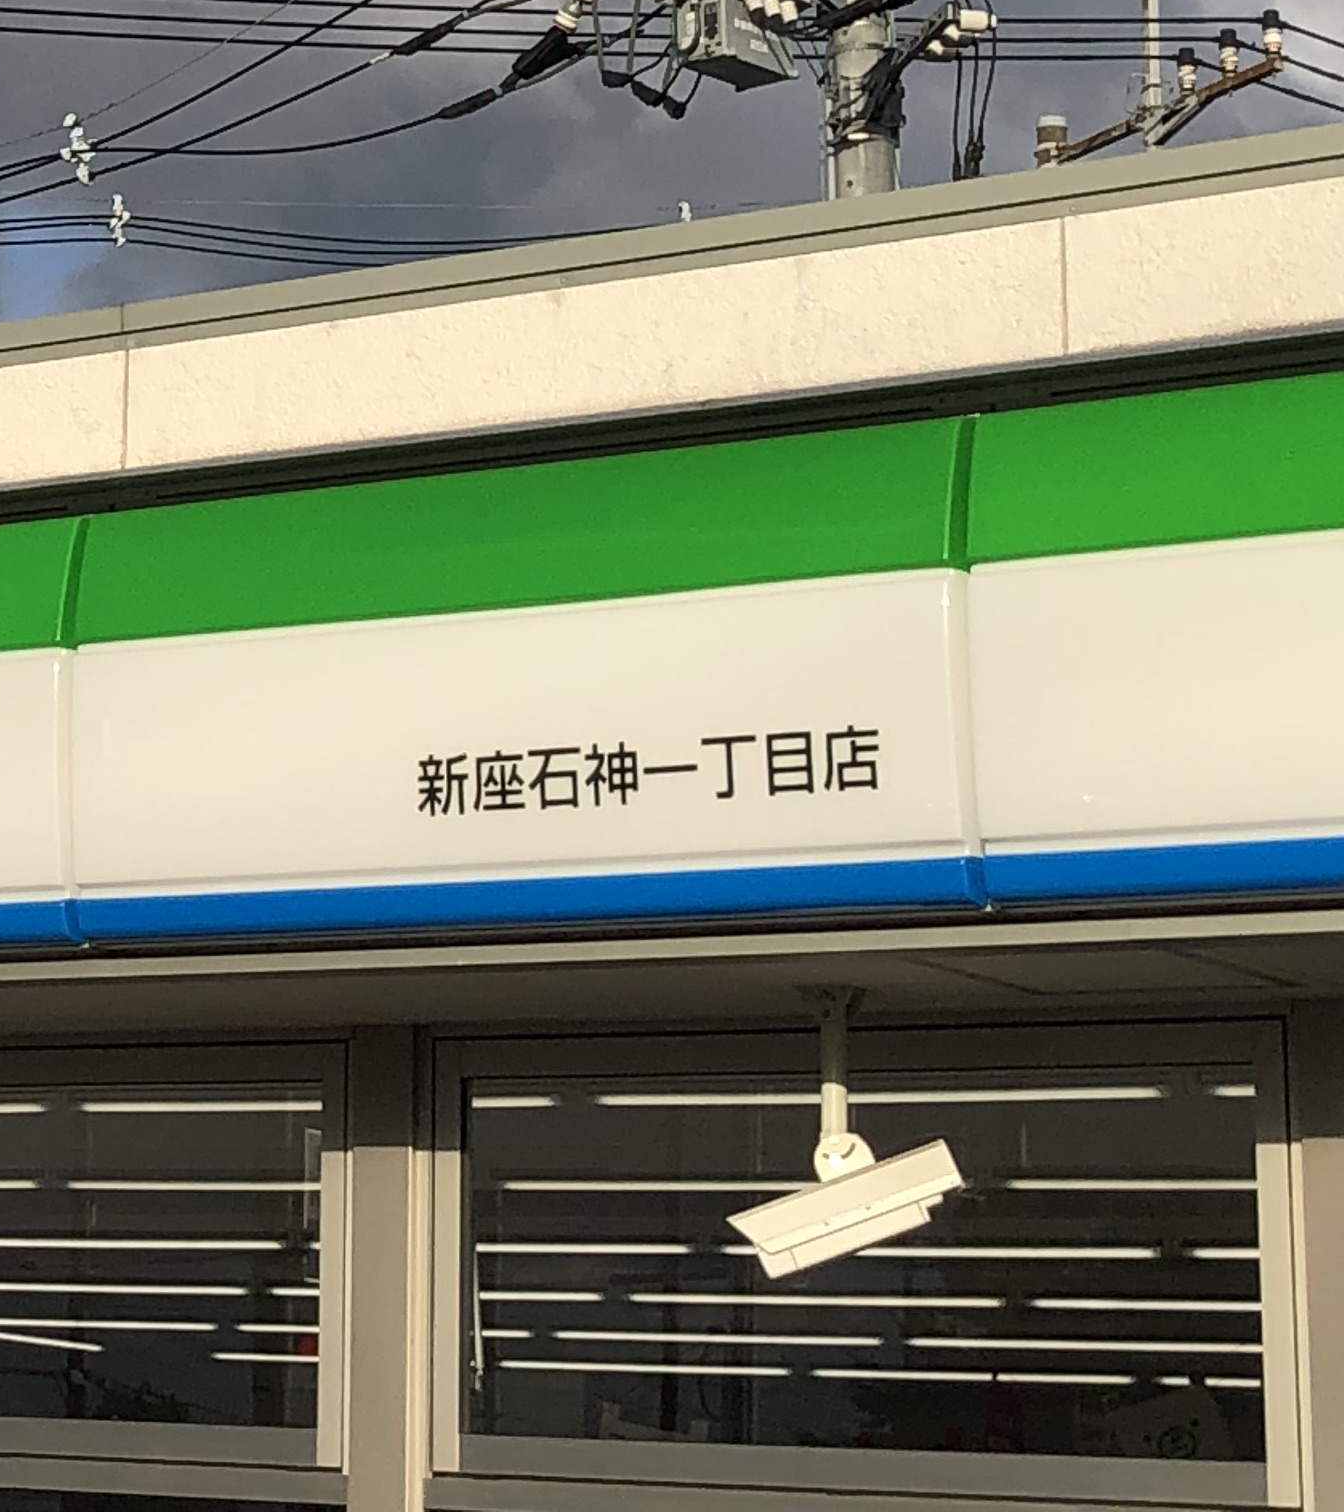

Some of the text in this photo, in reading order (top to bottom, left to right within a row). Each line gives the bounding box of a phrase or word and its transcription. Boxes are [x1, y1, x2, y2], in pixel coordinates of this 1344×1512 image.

[417, 724, 880, 816] 新座石神一丁目店
